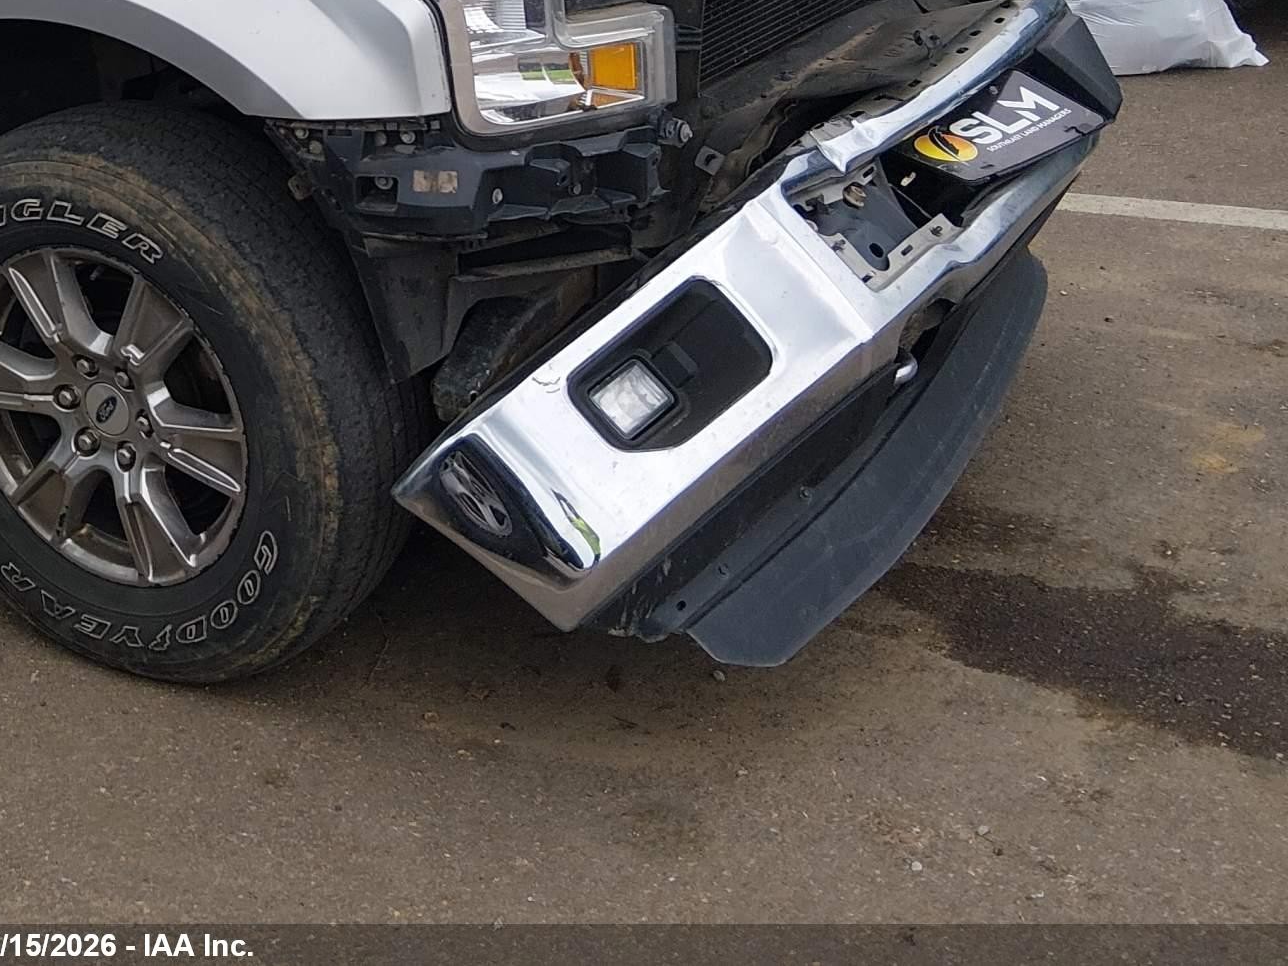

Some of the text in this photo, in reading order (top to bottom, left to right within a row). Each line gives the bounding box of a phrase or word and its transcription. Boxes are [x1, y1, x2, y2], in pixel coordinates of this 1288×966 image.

[949, 86, 1061, 145] SLM
[986, 108, 1072, 152] SOUTHEAST LAND MANAGERS
[0, 530, 279, 651] GOODYEAR
